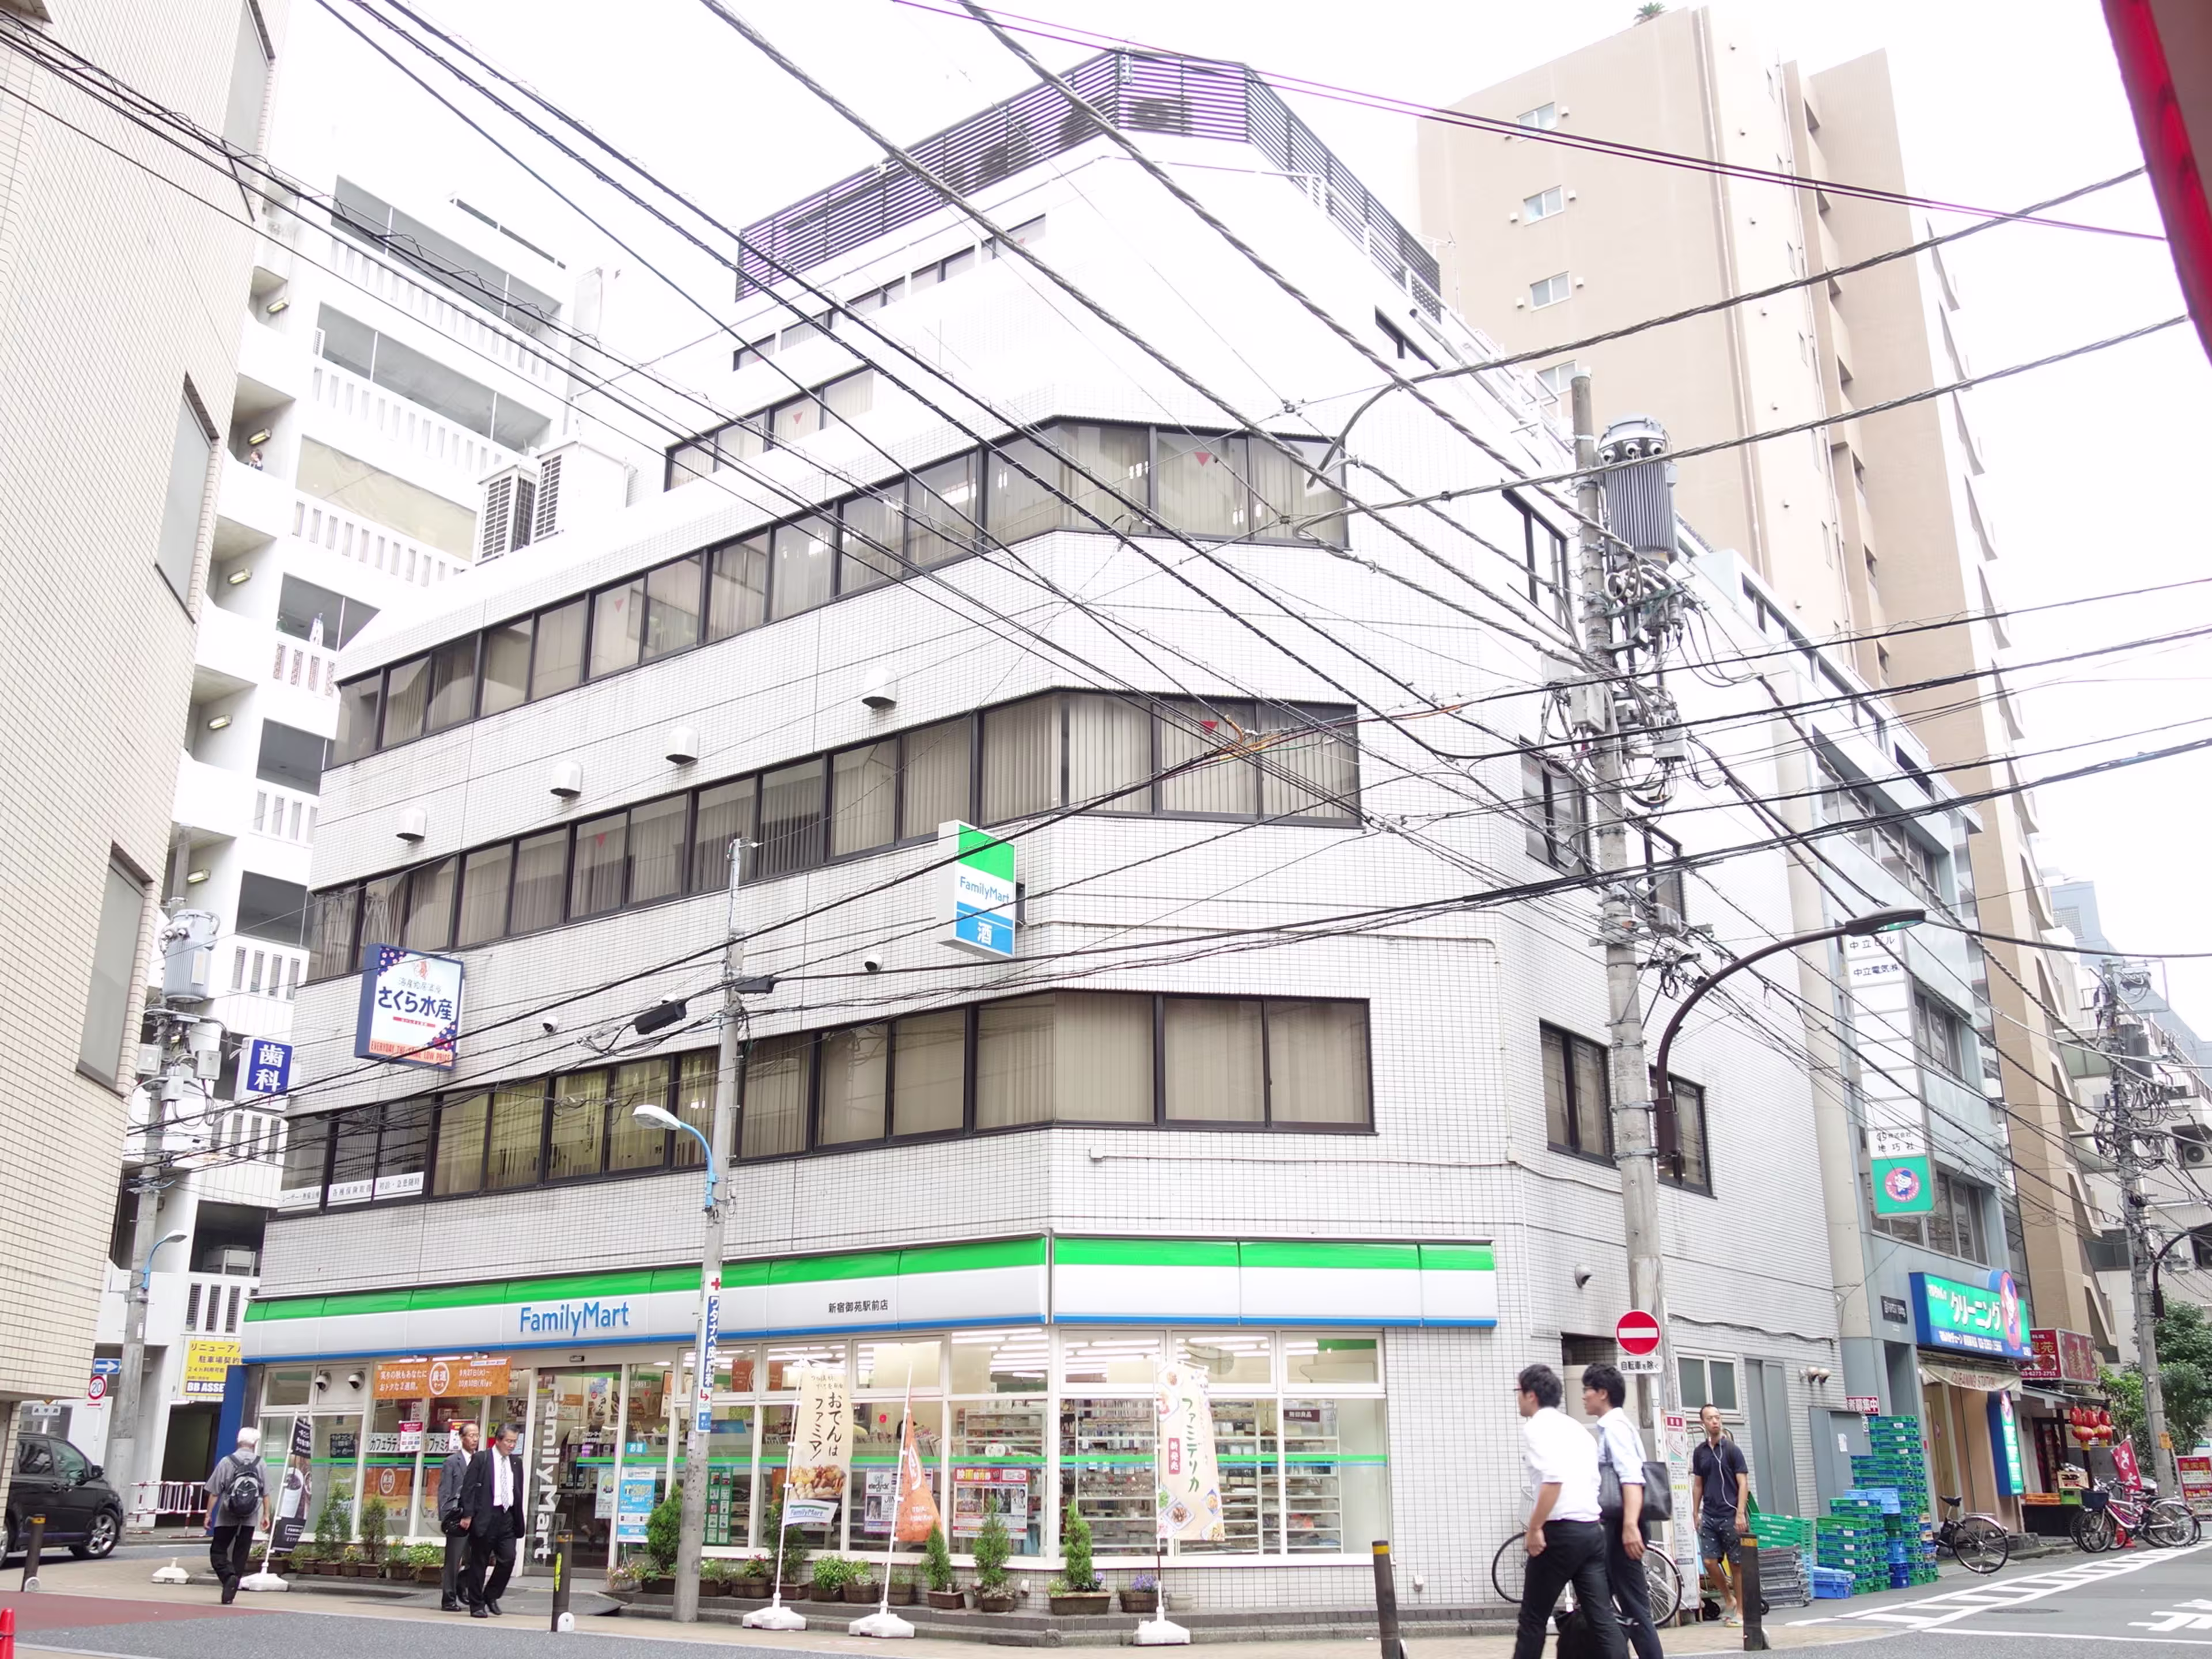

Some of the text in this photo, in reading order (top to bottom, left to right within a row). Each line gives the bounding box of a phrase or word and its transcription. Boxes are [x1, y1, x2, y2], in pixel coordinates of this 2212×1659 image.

[960, 876, 1009, 903] FamilyMart
[978, 921, 993, 945] 酒
[1850, 935, 1895, 949] 中立ビル
[378, 986, 453, 1021] さくら水産
[371, 1041, 395, 1053] EVERYDAY
[423, 1051, 435, 1060] LOW
[254, 1044, 285, 1092] 歯科
[520, 1301, 629, 1336] FamilyMart
[828, 1300, 888, 1313] 新宿御苑駅前店
[1950, 1291, 2001, 1331] クリーニング
[92, 1382, 102, 1393] 20
[187, 1382, 200, 1392] BB
[827, 1392, 843, 1457] おでんは
[1170, 1441, 1179, 1471] 新発売
[1182, 1397, 1200, 1493] ファミデリカ
[533, 1383, 565, 1560] FamilyMart
